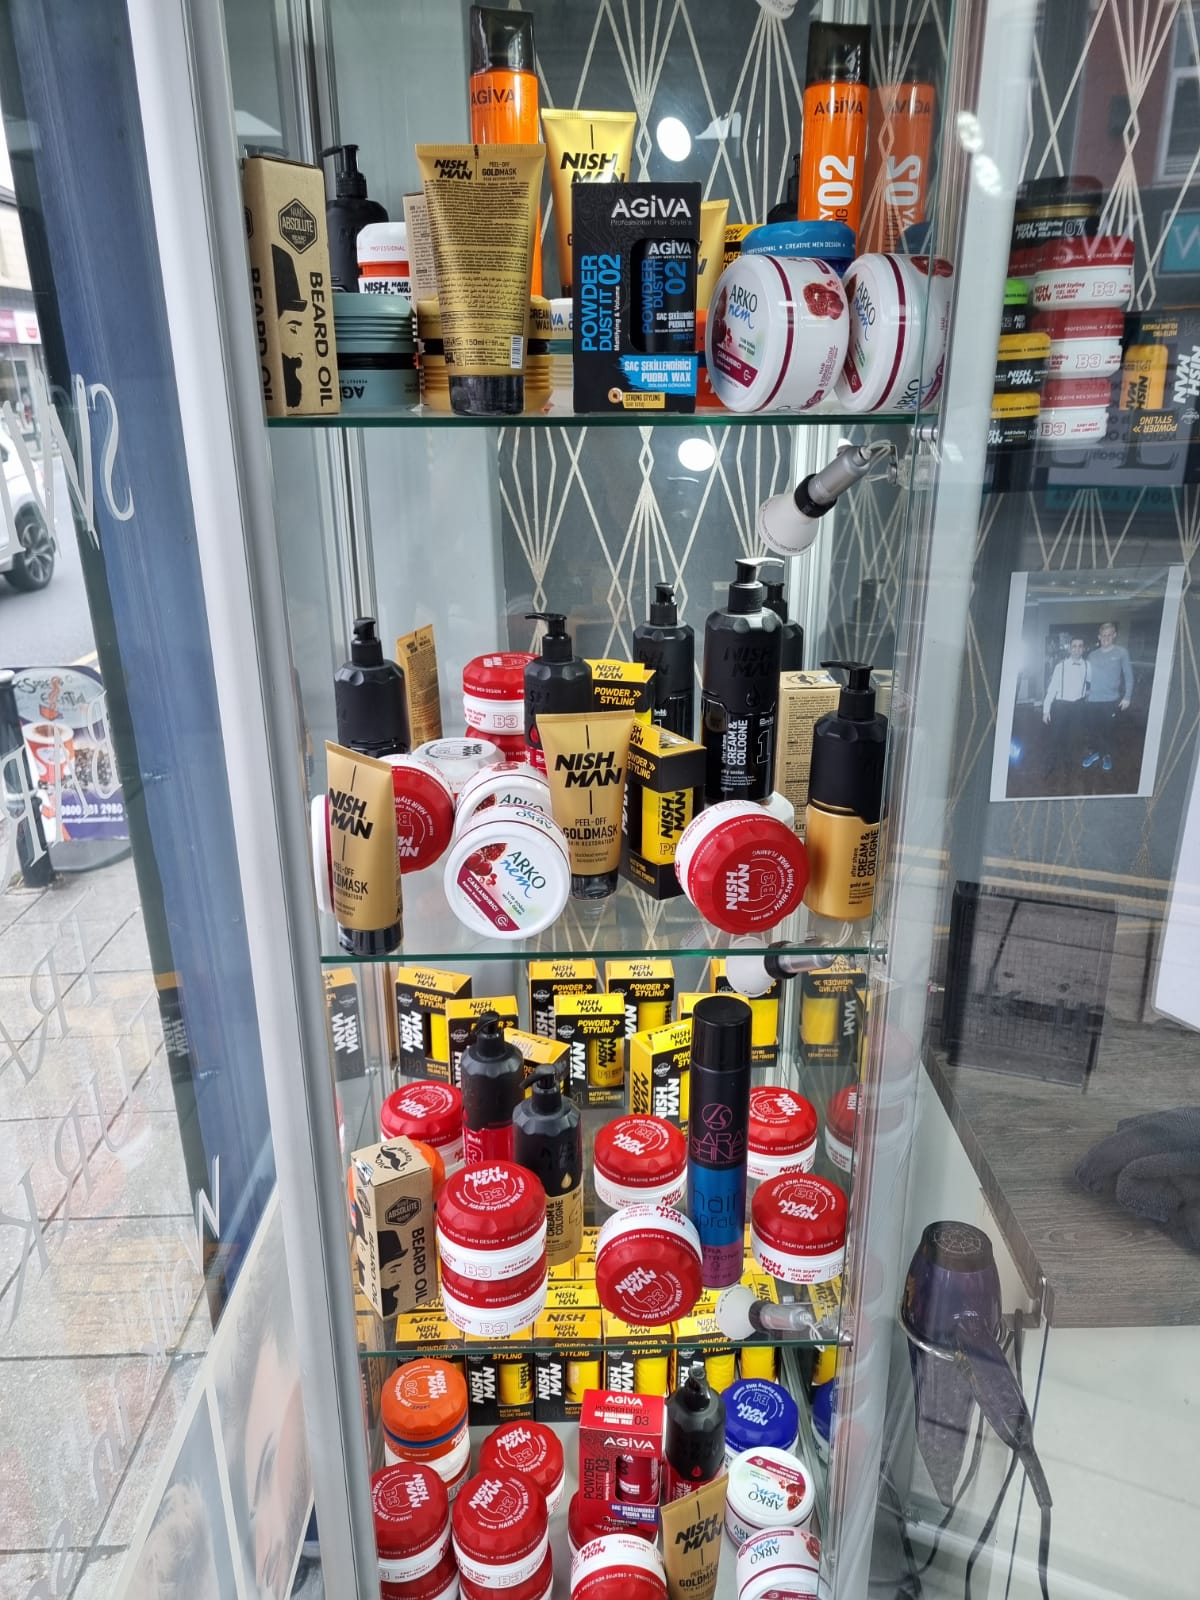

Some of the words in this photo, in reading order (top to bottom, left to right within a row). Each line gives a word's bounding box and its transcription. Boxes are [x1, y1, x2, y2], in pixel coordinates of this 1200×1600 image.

[434, 159, 469, 170] NISH
[439, 169, 473, 180] MAN
[818, 155, 855, 206] 02
[281, 216, 314, 234] ABSOLUTE
[598, 254, 621, 285] 02
[665, 262, 686, 295] 02
[364, 281, 390, 292] NISH
[600, 289, 613, 303] IT
[641, 259, 653, 334] POWDER
[729, 284, 758, 313] ARKO
[310, 272, 329, 358] BEARD
[581, 255, 597, 351] POWDER
[728, 303, 754, 330] nem
[857, 281, 876, 326] ARKO
[600, 309, 613, 351] DUST
[318, 368, 332, 407] OIL
[672, 372, 691, 383] WAX
[1007, 369, 1031, 379] NISH
[1011, 376, 1034, 385] MAN
[1173, 354, 1190, 404] MAN
[1139, 416, 1173, 425] STYLING
[595, 664, 621, 672] NISH
[598, 671, 623, 680] MAN
[594, 687, 630, 697] POWDER
[600, 696, 635, 706] STYLING
[493, 714, 518, 729] B3
[727, 730, 738, 766] CREAM
[736, 720, 748, 766] COLOGNE
[555, 752, 615, 771] NISH
[565, 768, 622, 788] MAN
[329, 787, 367, 820] NISH
[331, 808, 374, 840] MAN
[661, 797, 673, 838] NISH
[563, 824, 618, 840] GOLDMASK
[857, 843, 869, 878] CREAM
[867, 829, 879, 876] COLOGNE
[500, 859, 532, 899] nem
[508, 850, 546, 889] ARKO
[738, 864, 750, 902] MAN
[726, 871, 738, 910] NISH
[774, 894, 789, 911] HAIR
[415, 991, 443, 1002] POWDER
[400, 1013, 414, 1053] NISH
[411, 1011, 423, 1049] MAN
[572, 1042, 586, 1080] MAN
[668, 1079, 679, 1116] MAN
[376, 1159, 385, 1169] OIL
[464, 1166, 500, 1182] NISH
[473, 1171, 509, 1187] MAN
[388, 1203, 418, 1220] ABSOLUTE
[411, 1227, 426, 1276] BEARD
[760, 1253, 781, 1268] NISH
[464, 1263, 492, 1278] B3
[615, 1266, 645, 1294] NISH
[627, 1270, 657, 1296] MAN
[762, 1263, 785, 1278] MAN
[414, 1279, 428, 1303] OIL
[485, 1293, 522, 1302] PROFESSIONAL
[480, 1322, 508, 1334] B3
[547, 1314, 585, 1322] NISH
[427, 1375, 440, 1399] MAN
[435, 1370, 448, 1394] NISH
[471, 1371, 484, 1404] NISH
[483, 1366, 496, 1399] MAN
[539, 1367, 550, 1400] NISH
[550, 1362, 562, 1397] MAN
[634, 1416, 649, 1425] 03
[497, 1427, 522, 1447] NISH
[505, 1431, 531, 1451] MAN
[413, 1473, 430, 1501] NISH
[584, 1458, 594, 1499] POWDER
[405, 1481, 422, 1508] MAN
[469, 1479, 492, 1509] NISH
[480, 1479, 503, 1509] MAN
[748, 1490, 784, 1510] ARKO
[498, 1520, 514, 1529] HAIR
[675, 1513, 719, 1544] NISH
[683, 1521, 723, 1554] MAN
[750, 1544, 780, 1564] ARKO
